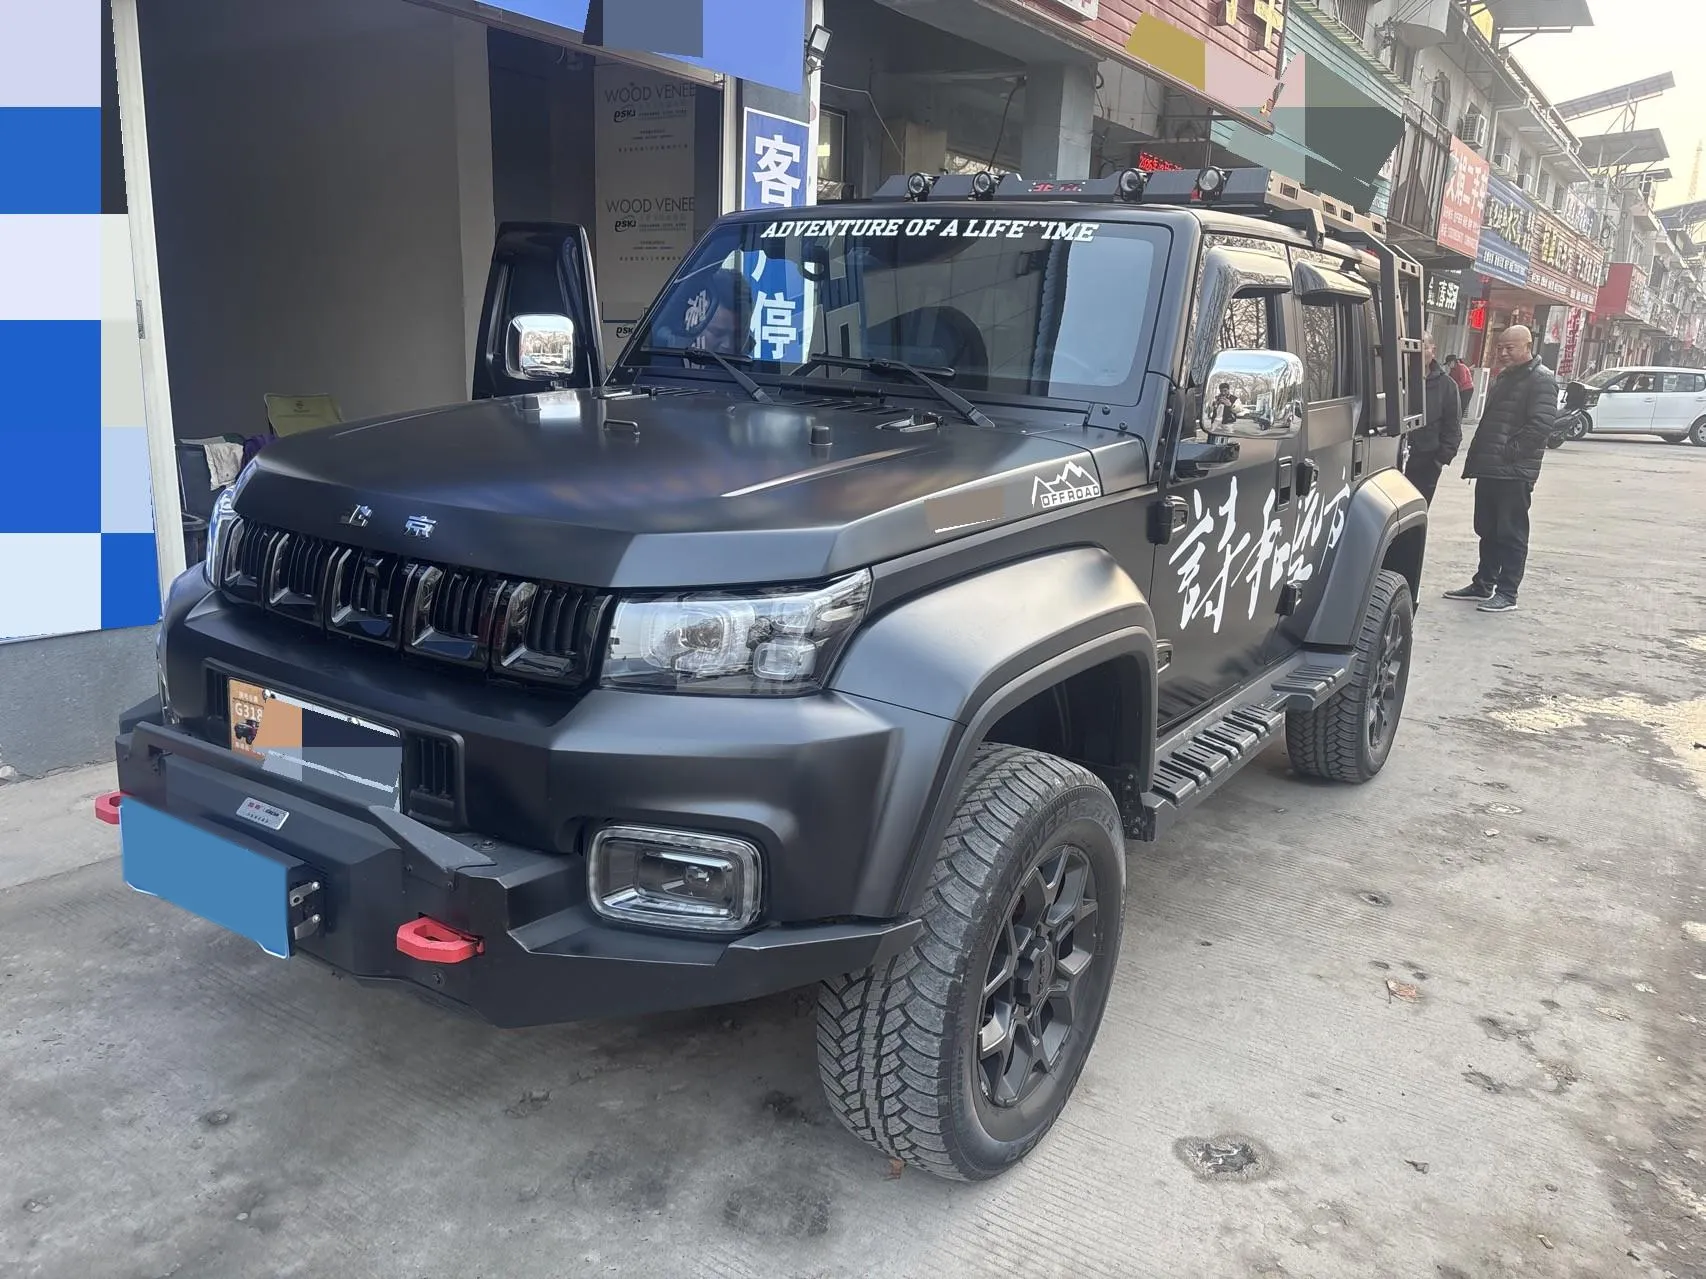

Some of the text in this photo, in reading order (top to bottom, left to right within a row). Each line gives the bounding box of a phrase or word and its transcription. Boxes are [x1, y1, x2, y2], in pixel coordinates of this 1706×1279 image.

[605, 85, 652, 103] WOOD
[606, 198, 652, 213] WOOD
[760, 218, 1100, 242] ADVENTURE OF A LIFEIME
[1041, 485, 1100, 506] OFFROAD
